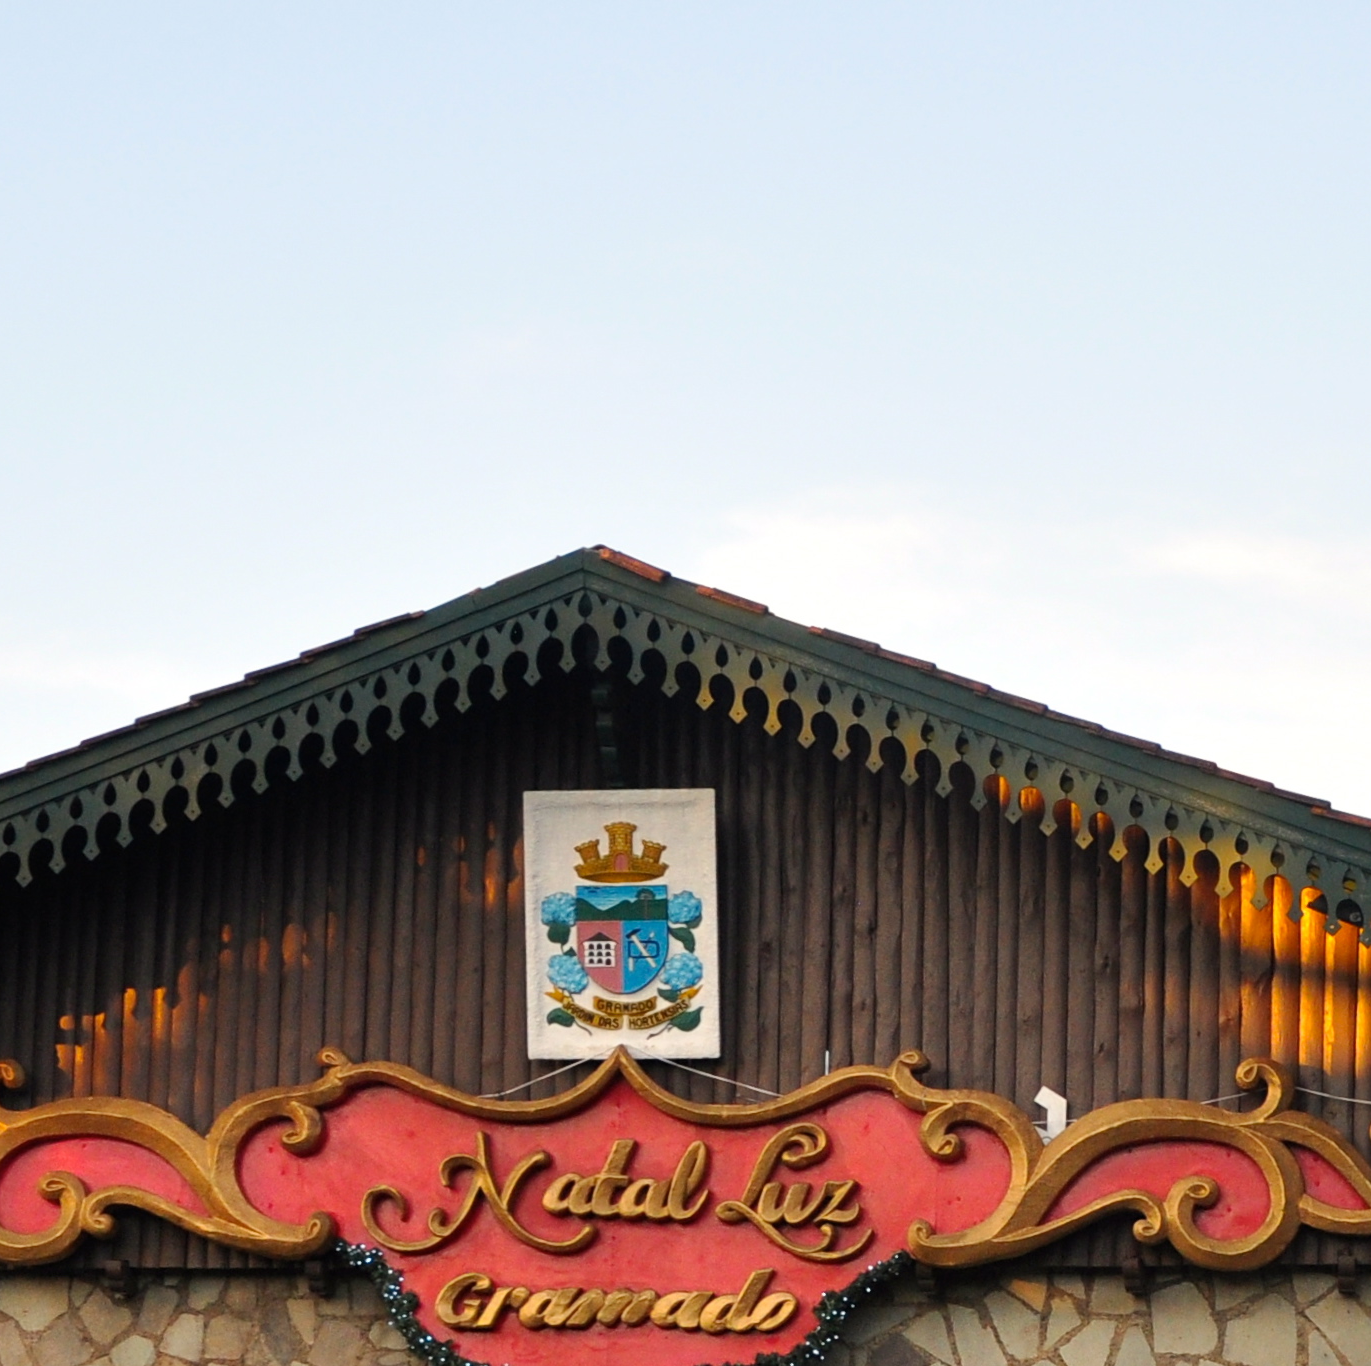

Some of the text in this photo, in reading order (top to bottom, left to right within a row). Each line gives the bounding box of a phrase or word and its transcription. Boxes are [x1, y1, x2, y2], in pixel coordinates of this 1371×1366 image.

[596, 1000, 654, 1013] GRAMADO
[597, 1017, 620, 1029] DAS
[361, 1122, 874, 1262] Natal Luz
[435, 1268, 800, 1334] Gramado
